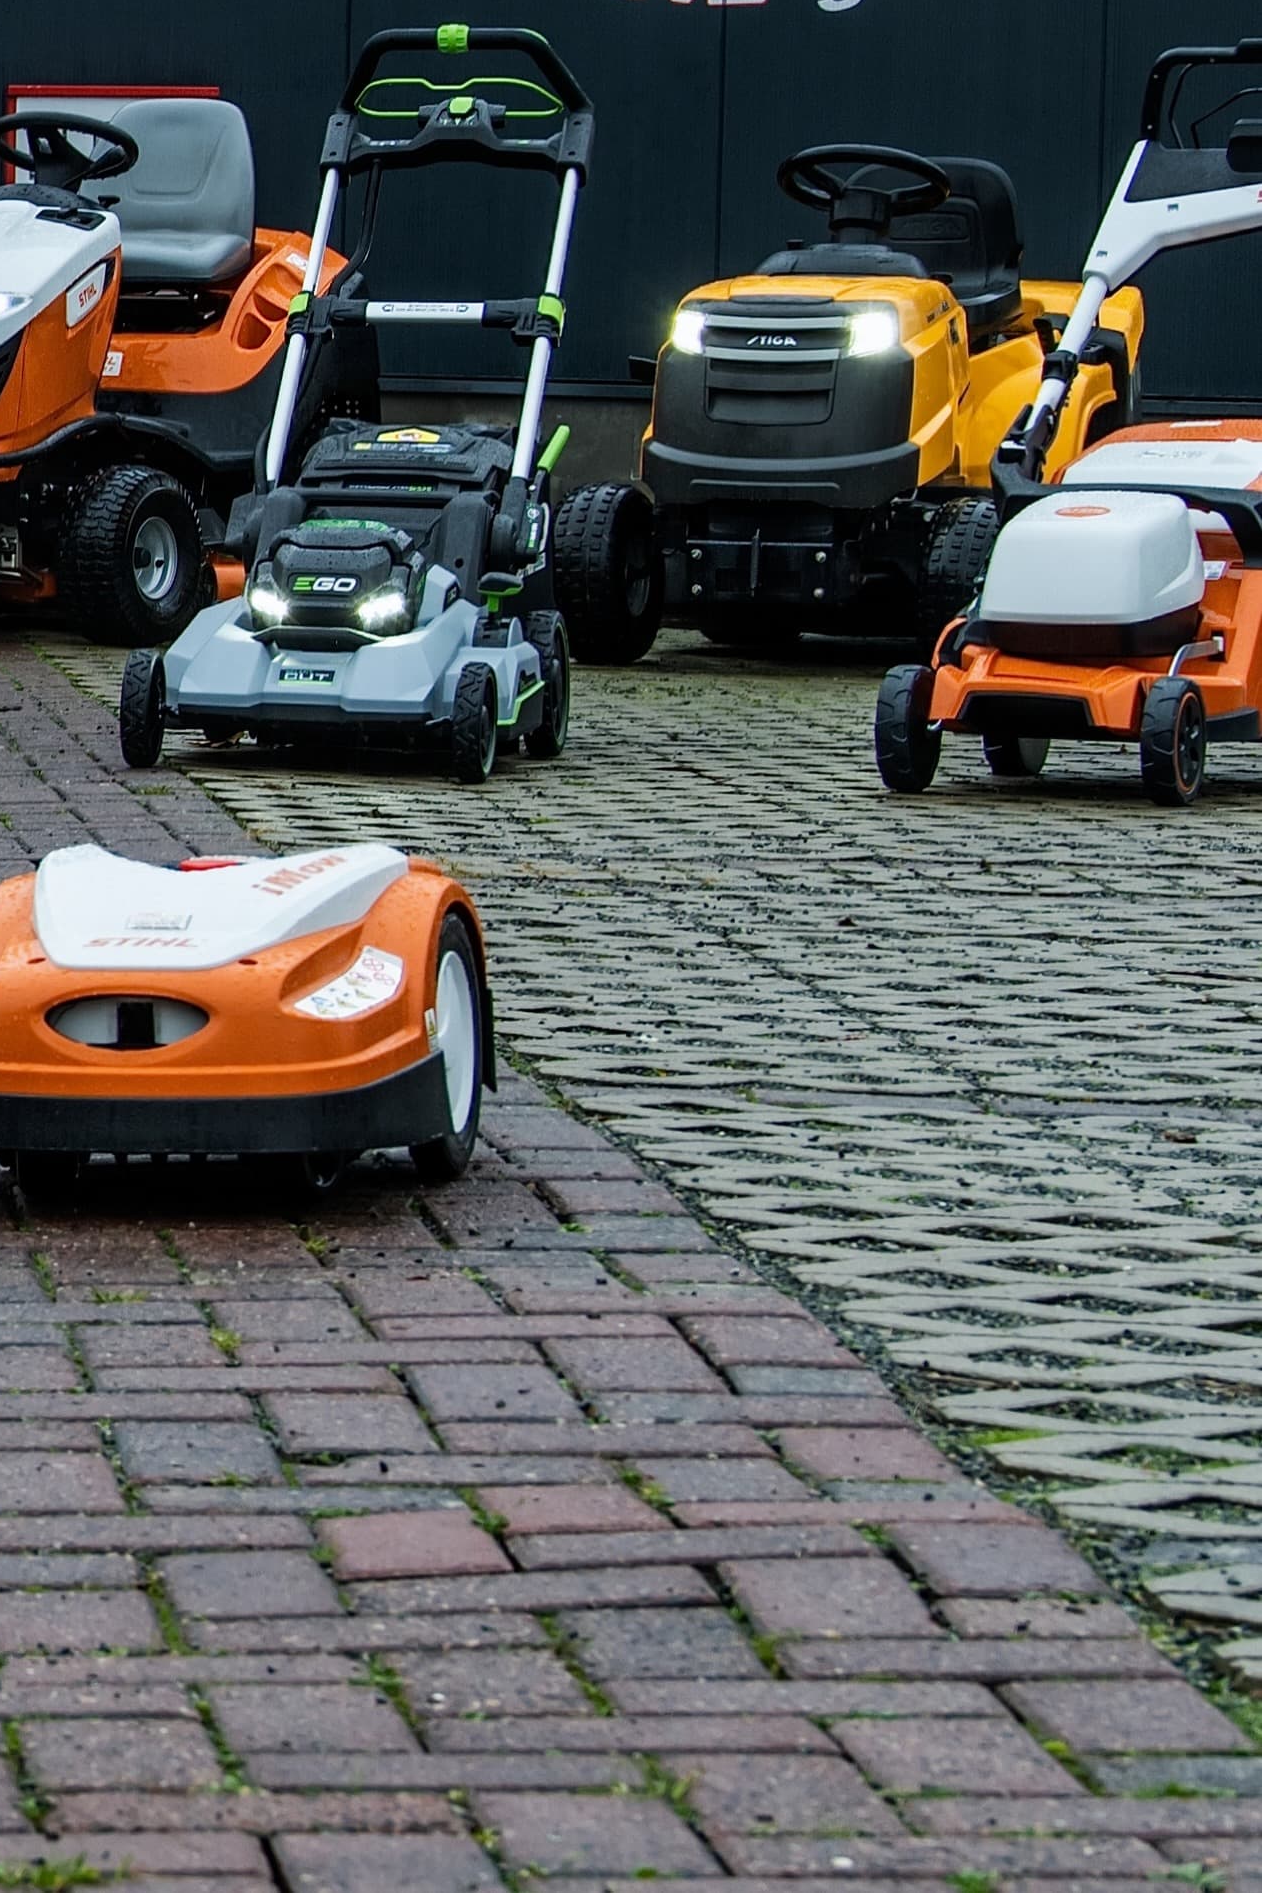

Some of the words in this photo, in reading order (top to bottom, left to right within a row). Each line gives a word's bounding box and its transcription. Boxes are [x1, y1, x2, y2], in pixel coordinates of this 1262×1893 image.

[78, 282, 98, 308] STIHL
[747, 335, 797, 346] STIGA
[292, 576, 357, 592] EGO
[82, 936, 198, 948] STIHL
